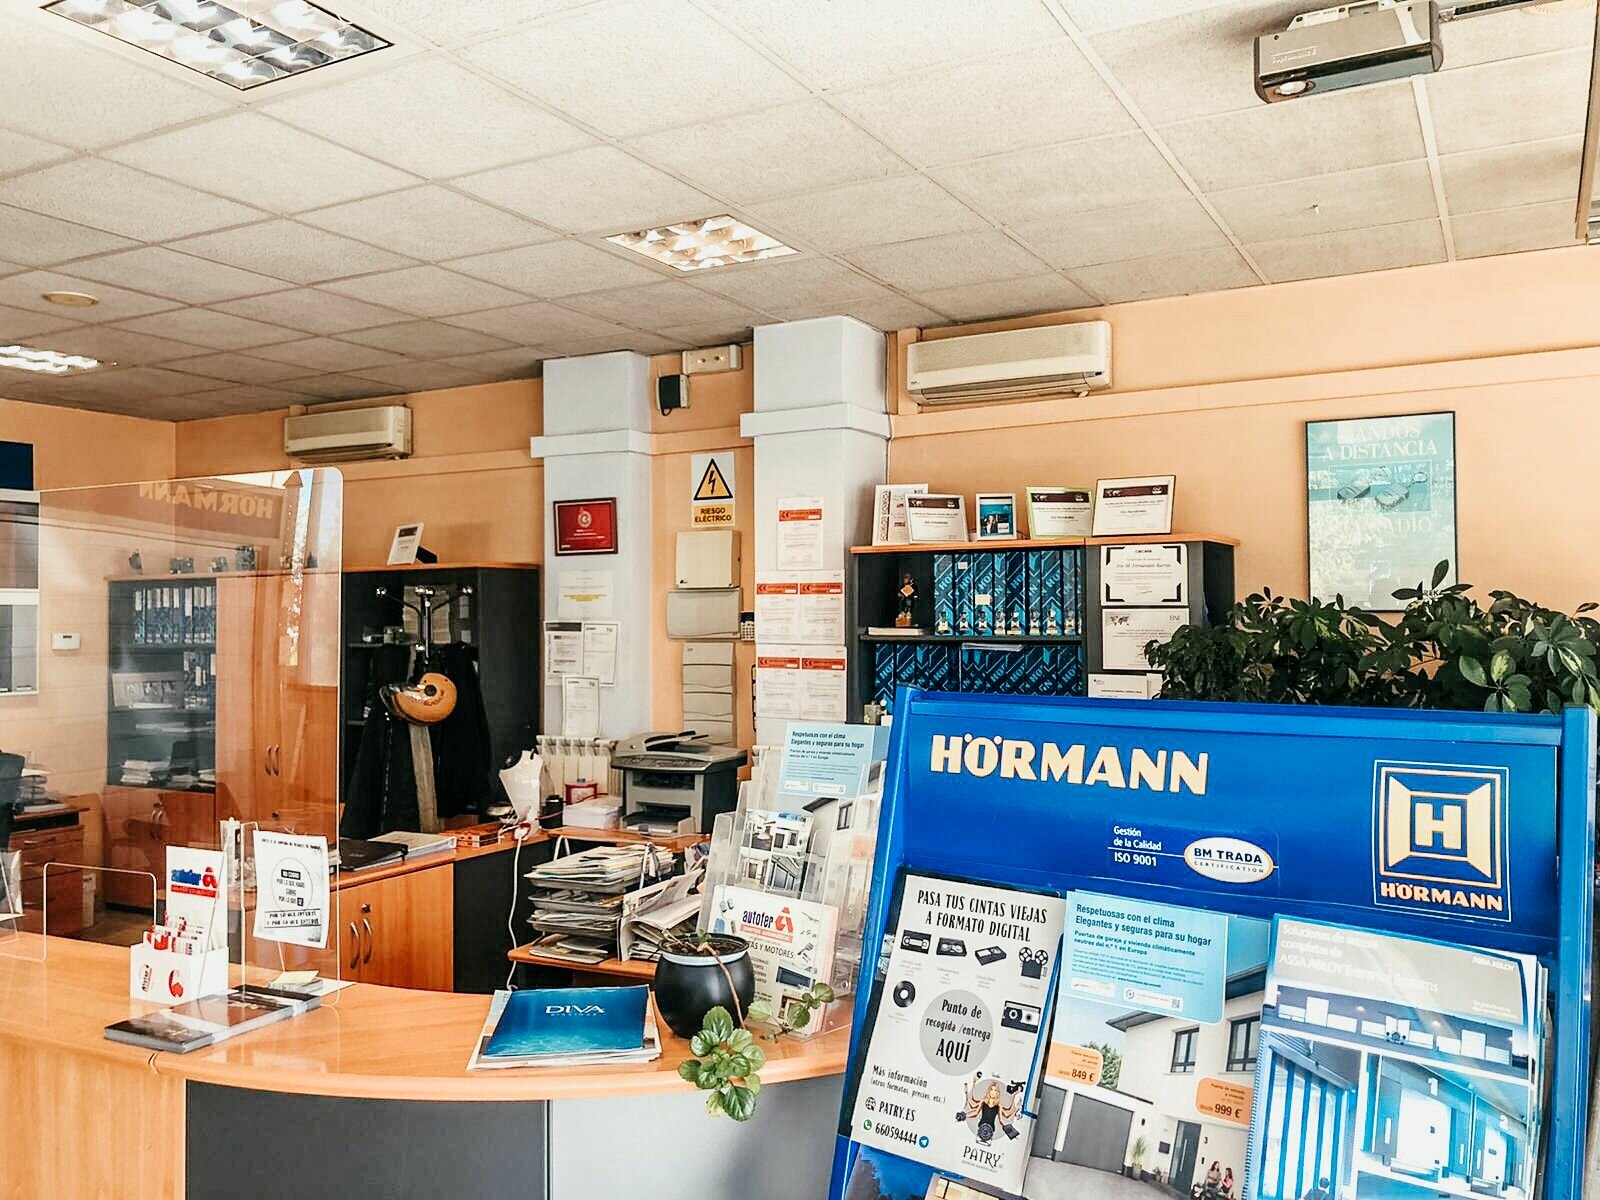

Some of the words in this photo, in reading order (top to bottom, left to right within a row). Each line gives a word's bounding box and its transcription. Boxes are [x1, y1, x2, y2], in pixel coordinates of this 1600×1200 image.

[1346, 424, 1421, 443] ANDOS
[1322, 447, 1335, 461] A
[1340, 439, 1438, 460] DISTANCIA
[700, 507, 726, 515] RIESGO
[1376, 516, 1432, 536] ADIO
[930, 733, 1209, 795] HÖRMANN
[1114, 826, 1142, 837] Gestión
[1114, 838, 1123, 846] de
[1124, 838, 1132, 848] la
[1133, 840, 1162, 850] Calidad
[1114, 852, 1130, 863] ISO
[1133, 854, 1157, 867] 9001
[1194, 847, 1212, 858] BM
[1216, 850, 1262, 864] TRADA
[1194, 861, 1264, 874] CERTIFICATION
[1380, 882, 1503, 911] HÖRMANN
[918, 890, 941, 907] PASA
[946, 894, 965, 910] TUS
[969, 898, 1006, 918] CINTAS
[1010, 904, 1048, 924] VIEJAS
[1076, 904, 1125, 920] Respetuosas
[1126, 912, 1141, 922] con
[1144, 915, 1151, 924] el
[1152, 916, 1175, 928] clima
[742, 910, 774, 928] autofer
[926, 910, 932, 925] A
[936, 912, 985, 934] FORMATO
[989, 922, 1031, 942] DIGITAL
[1076, 916, 1112, 930] Elegantes
[1114, 923, 1120, 932] y
[1121, 924, 1153, 936] seguras
[1154, 930, 1173, 940] para
[1175, 933, 1186, 942] su
[1187, 934, 1212, 947] hogar
[765, 946, 794, 958] MOTORES
[546, 1004, 606, 1014] DIVA
[942, 999, 968, 1016] Punto
[970, 1004, 982, 1019] de
[925, 1018, 956, 1034] recogida
[936, 1038, 972, 1062] AQUÍ
[872, 1064, 886, 1077] Más
[888, 1069, 928, 1088] información
[1072, 1068, 1087, 1080] 849
[1090, 1072, 1096, 1082] €
[878, 1101, 916, 1121] PATRY.ES
[1214, 1104, 1232, 1116] 999
[1235, 1109, 1243, 1118] €
[875, 1123, 918, 1145] 660594444
[963, 1145, 1001, 1168] PATRY
